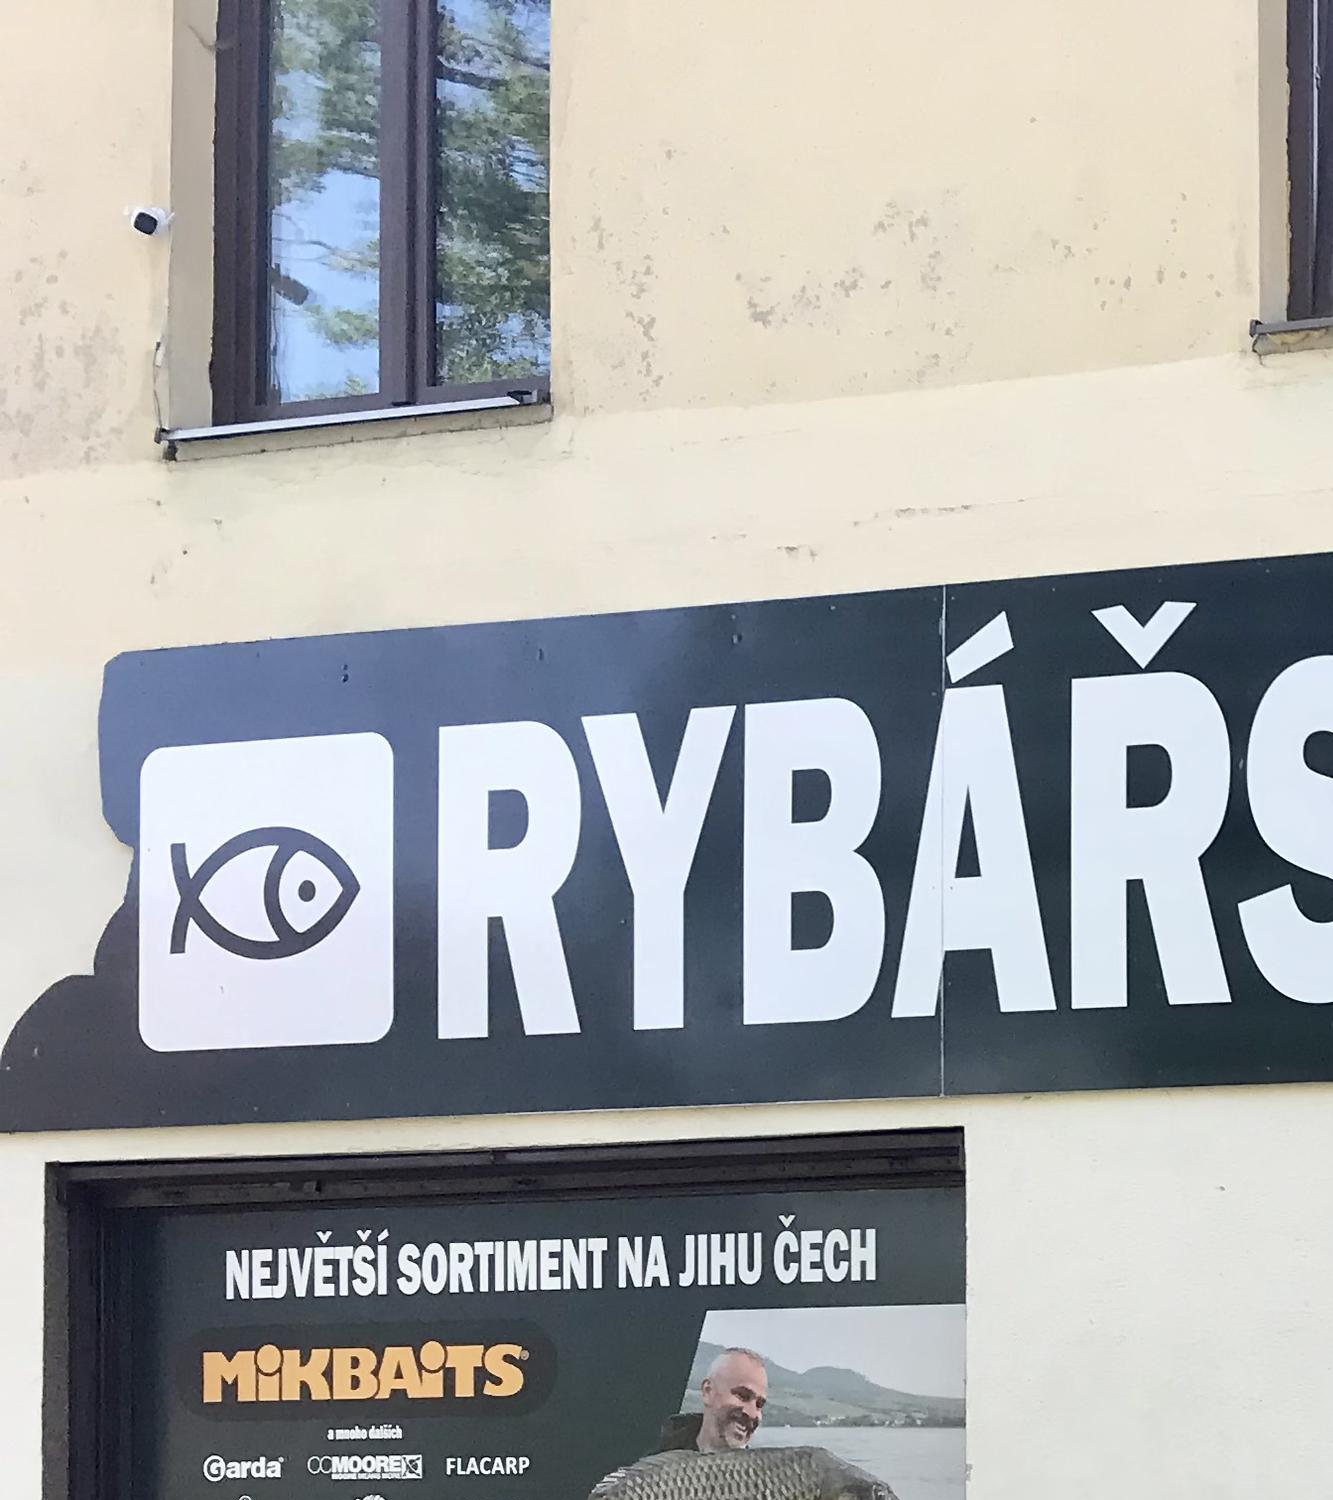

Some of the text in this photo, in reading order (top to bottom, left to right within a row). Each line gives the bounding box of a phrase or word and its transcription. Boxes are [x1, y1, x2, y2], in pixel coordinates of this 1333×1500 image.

[225, 1214, 878, 1300] NEJVĚTŠÍ SORTIMENT NA JIHU ČECH
[336, 1427, 367, 1440] mnoho
[369, 1424, 403, 1440] dalších
[203, 1455, 283, 1482] Garda
[446, 1456, 530, 1476] FLACARP
